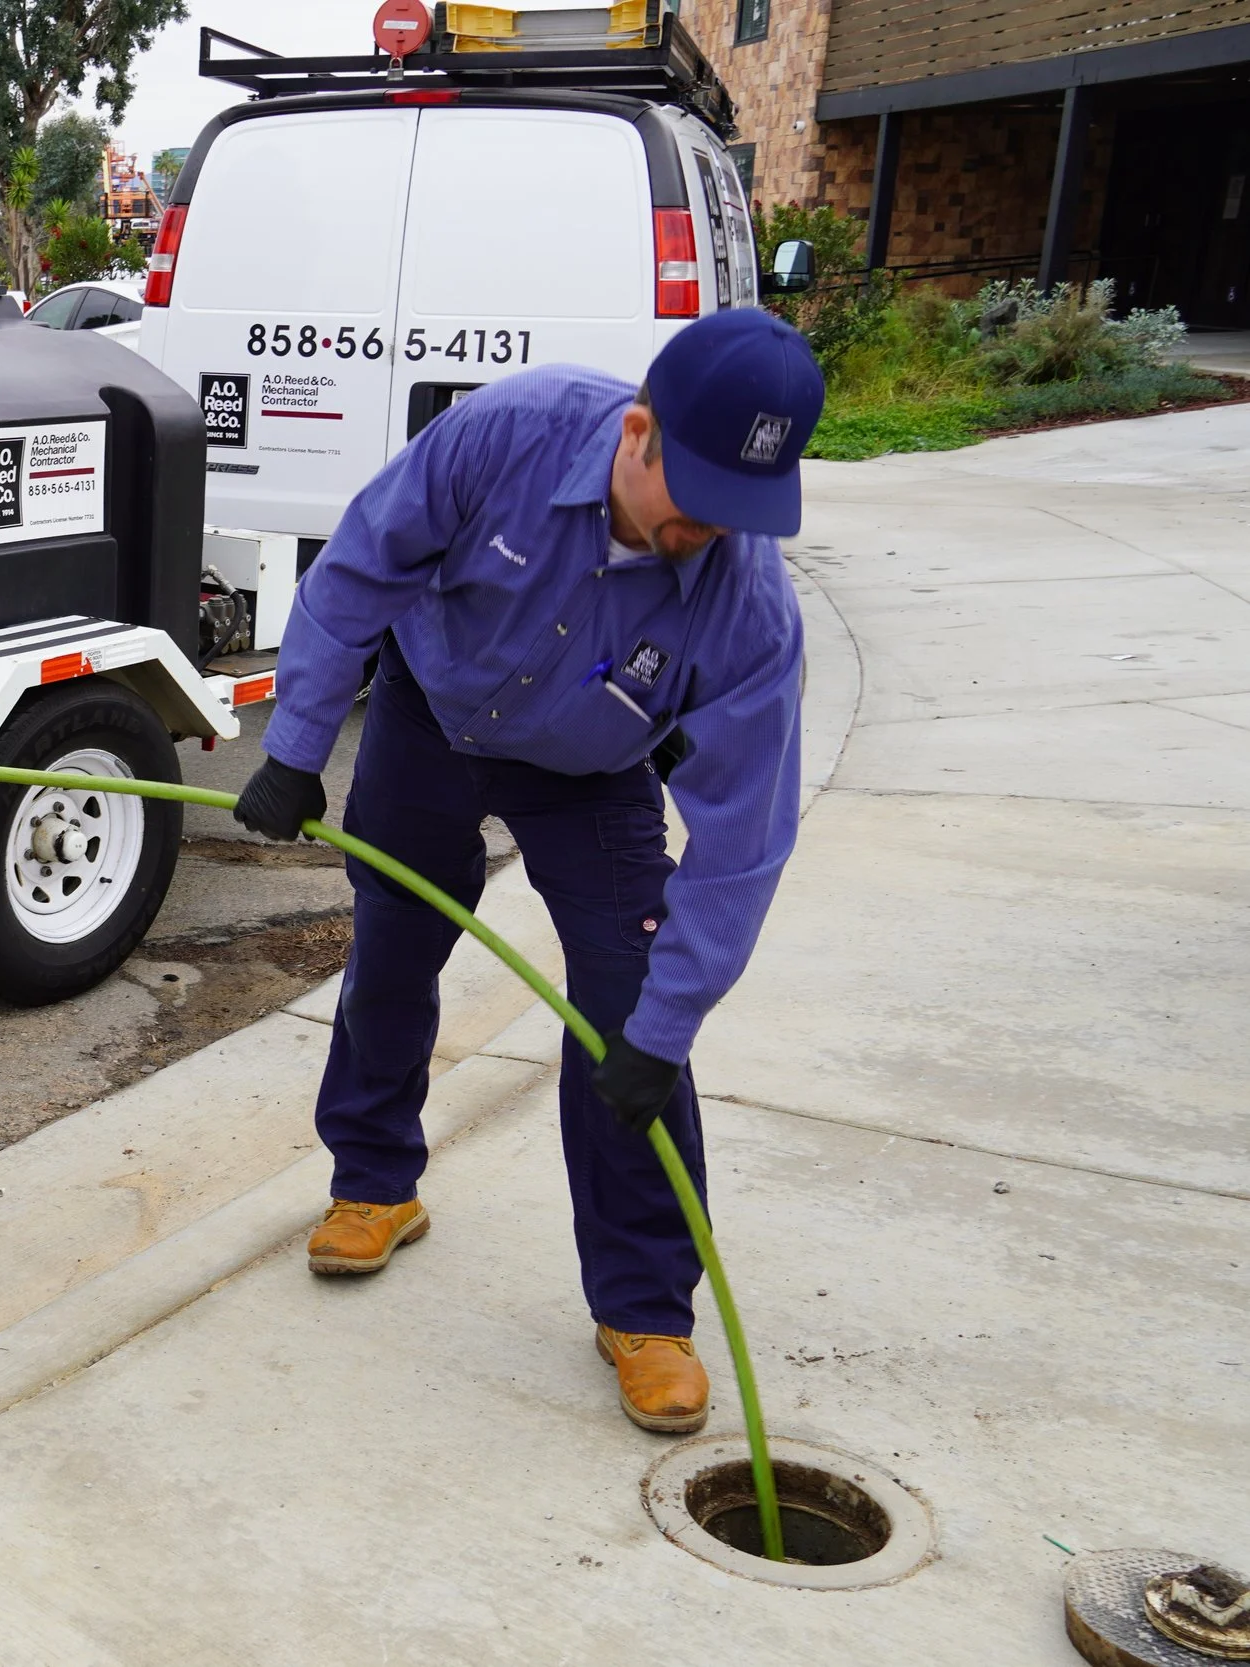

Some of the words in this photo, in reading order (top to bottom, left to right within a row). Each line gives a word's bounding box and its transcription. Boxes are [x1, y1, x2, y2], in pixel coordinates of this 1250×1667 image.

[210, 381, 238, 396] A.O.
[262, 385, 318, 396] Mechanical
[204, 396, 243, 412] Reed
[262, 396, 318, 406] Contractor
[205, 412, 240, 428] &Co.
[31, 444, 78, 456] Mechanical
[30, 456, 75, 466] Contractor
[206, 463, 259, 474] PRESS
[2, 508, 14, 516] 1914
